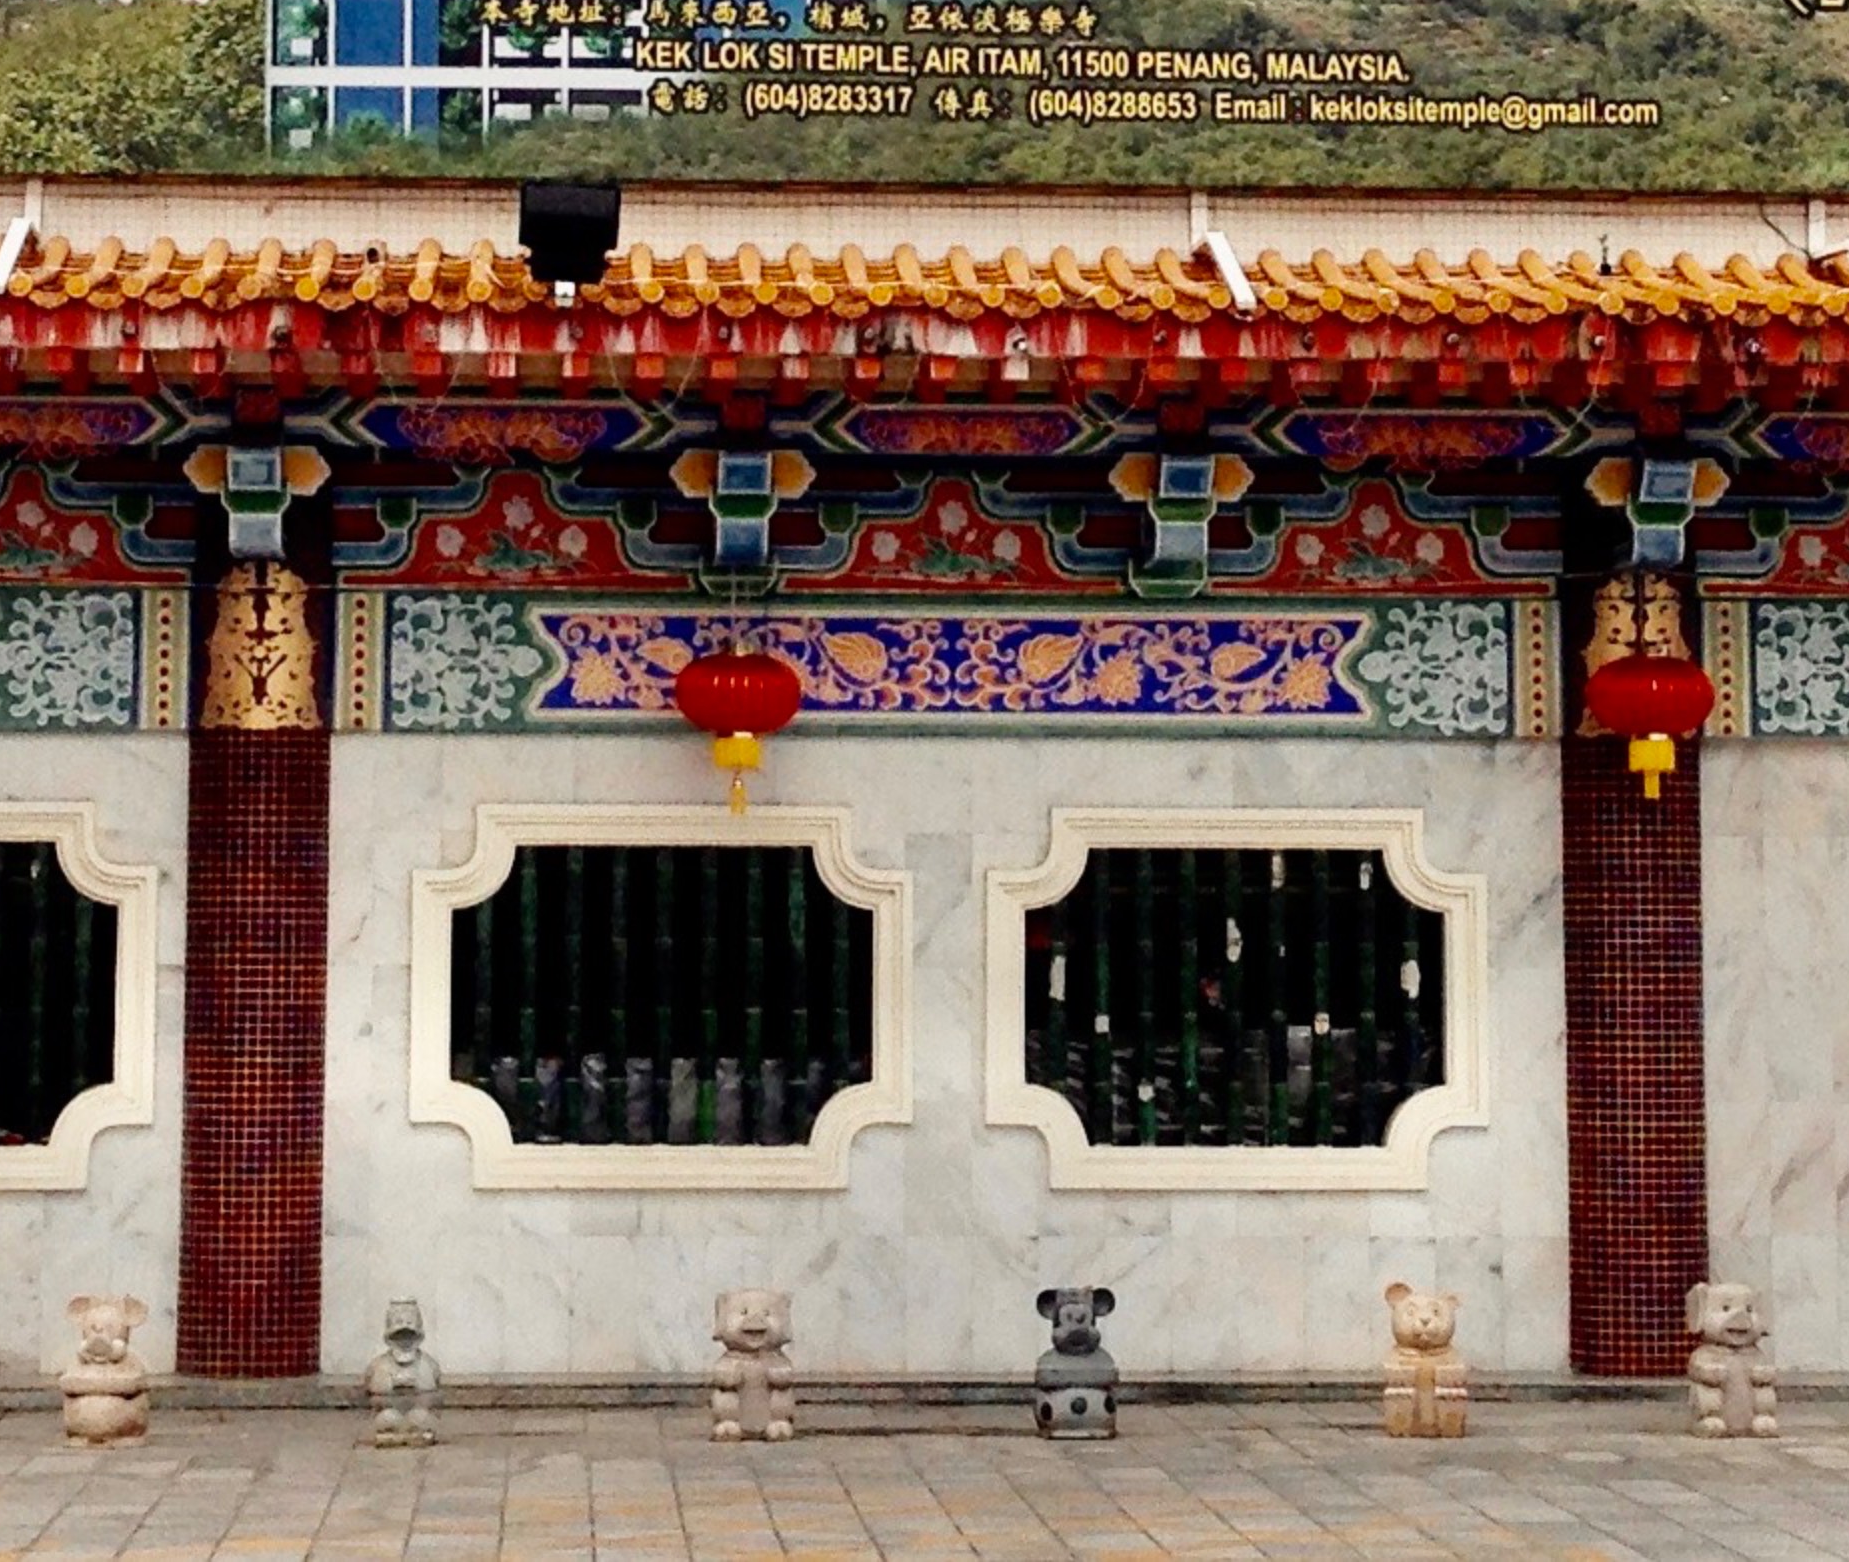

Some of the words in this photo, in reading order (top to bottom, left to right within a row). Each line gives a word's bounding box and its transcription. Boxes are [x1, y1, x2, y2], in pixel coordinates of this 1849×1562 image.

[635, 40, 693, 69] KEK
[702, 41, 761, 70] LOK
[767, 41, 794, 70] SI
[800, 42, 918, 77] TEMPLE,
[922, 46, 971, 75] AIR
[977, 47, 1050, 80] ITAM,
[1056, 49, 1130, 78] 11500
[1136, 51, 1259, 84] PENANG,
[1265, 52, 1410, 83] MALAYSIA.
[745, 81, 914, 117] (604)8283317
[1029, 88, 1197, 125] (604)8288653
[1309, 93, 1658, 131] kekloksitemple@gmail.com
